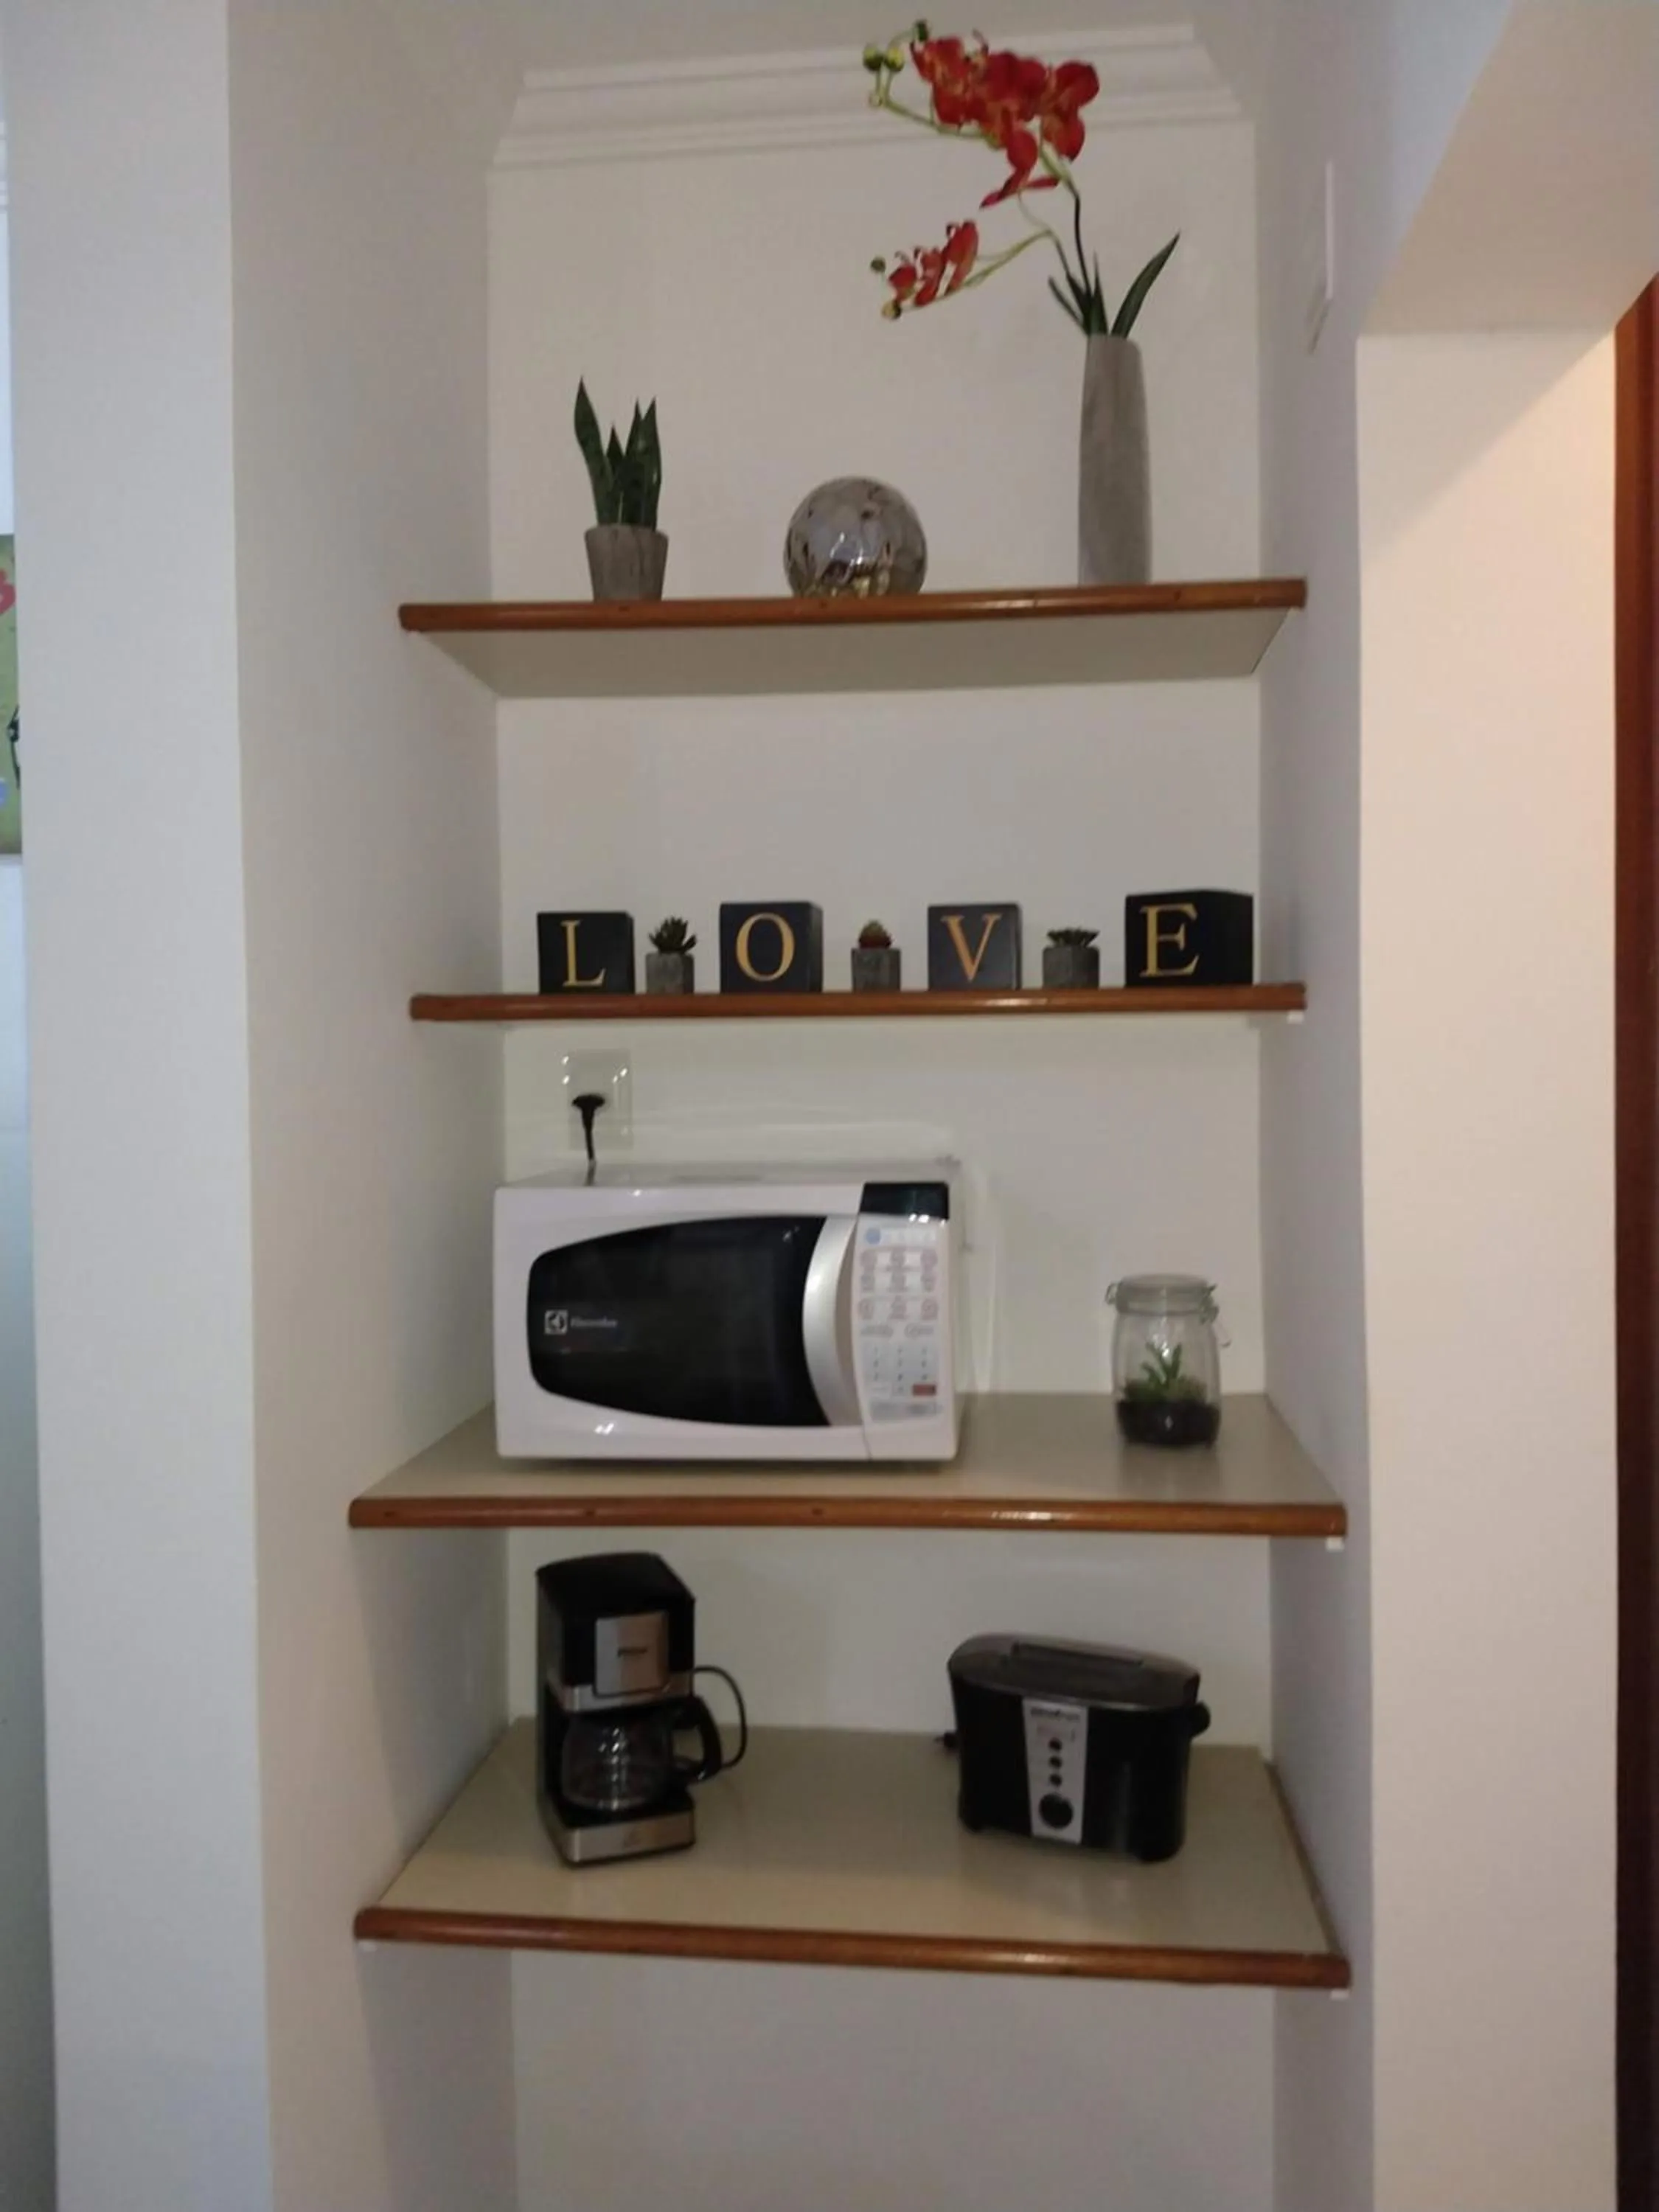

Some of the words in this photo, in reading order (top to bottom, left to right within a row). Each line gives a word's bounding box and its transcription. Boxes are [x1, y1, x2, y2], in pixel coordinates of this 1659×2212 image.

[561, 920, 606, 987] L
[735, 913, 795, 982] O
[942, 914, 1001, 981] V
[1138, 902, 1199, 977] E
